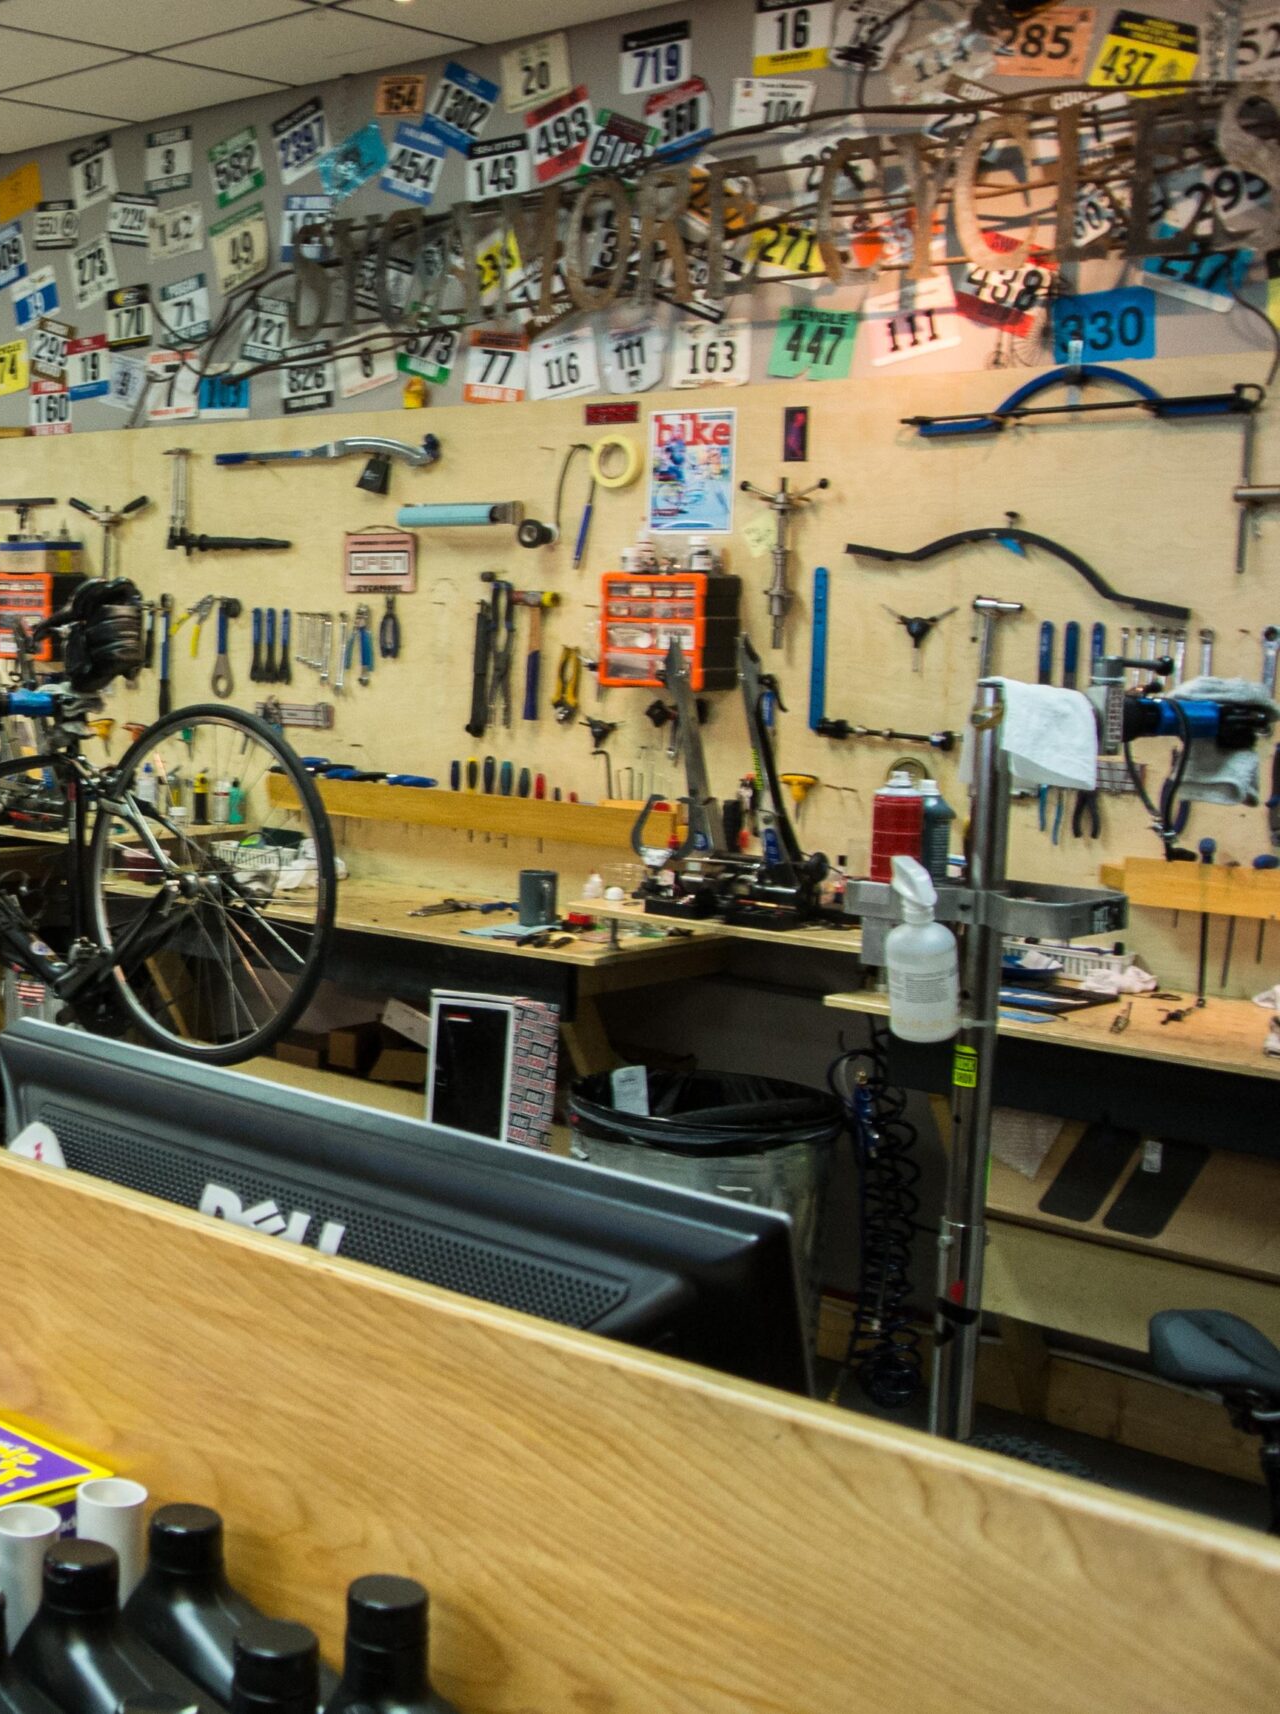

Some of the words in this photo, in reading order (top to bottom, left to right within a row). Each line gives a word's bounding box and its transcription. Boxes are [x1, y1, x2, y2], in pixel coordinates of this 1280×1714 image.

[775, 9, 811, 51] 16
[523, 61, 550, 96] 20
[633, 43, 681, 89] 719
[1099, 45, 1157, 86] 437
[432, 83, 491, 138] 1302
[537, 105, 590, 156] 493
[389, 147, 436, 189] 454
[476, 155, 517, 196] 143
[230, 230, 254, 265] 49
[786, 322, 845, 366] 447
[1060, 305, 1145, 354] 330
[480, 348, 515, 386] 77
[545, 352, 580, 390] 116
[688, 340, 737, 374] 163
[655, 413, 731, 447] bike
